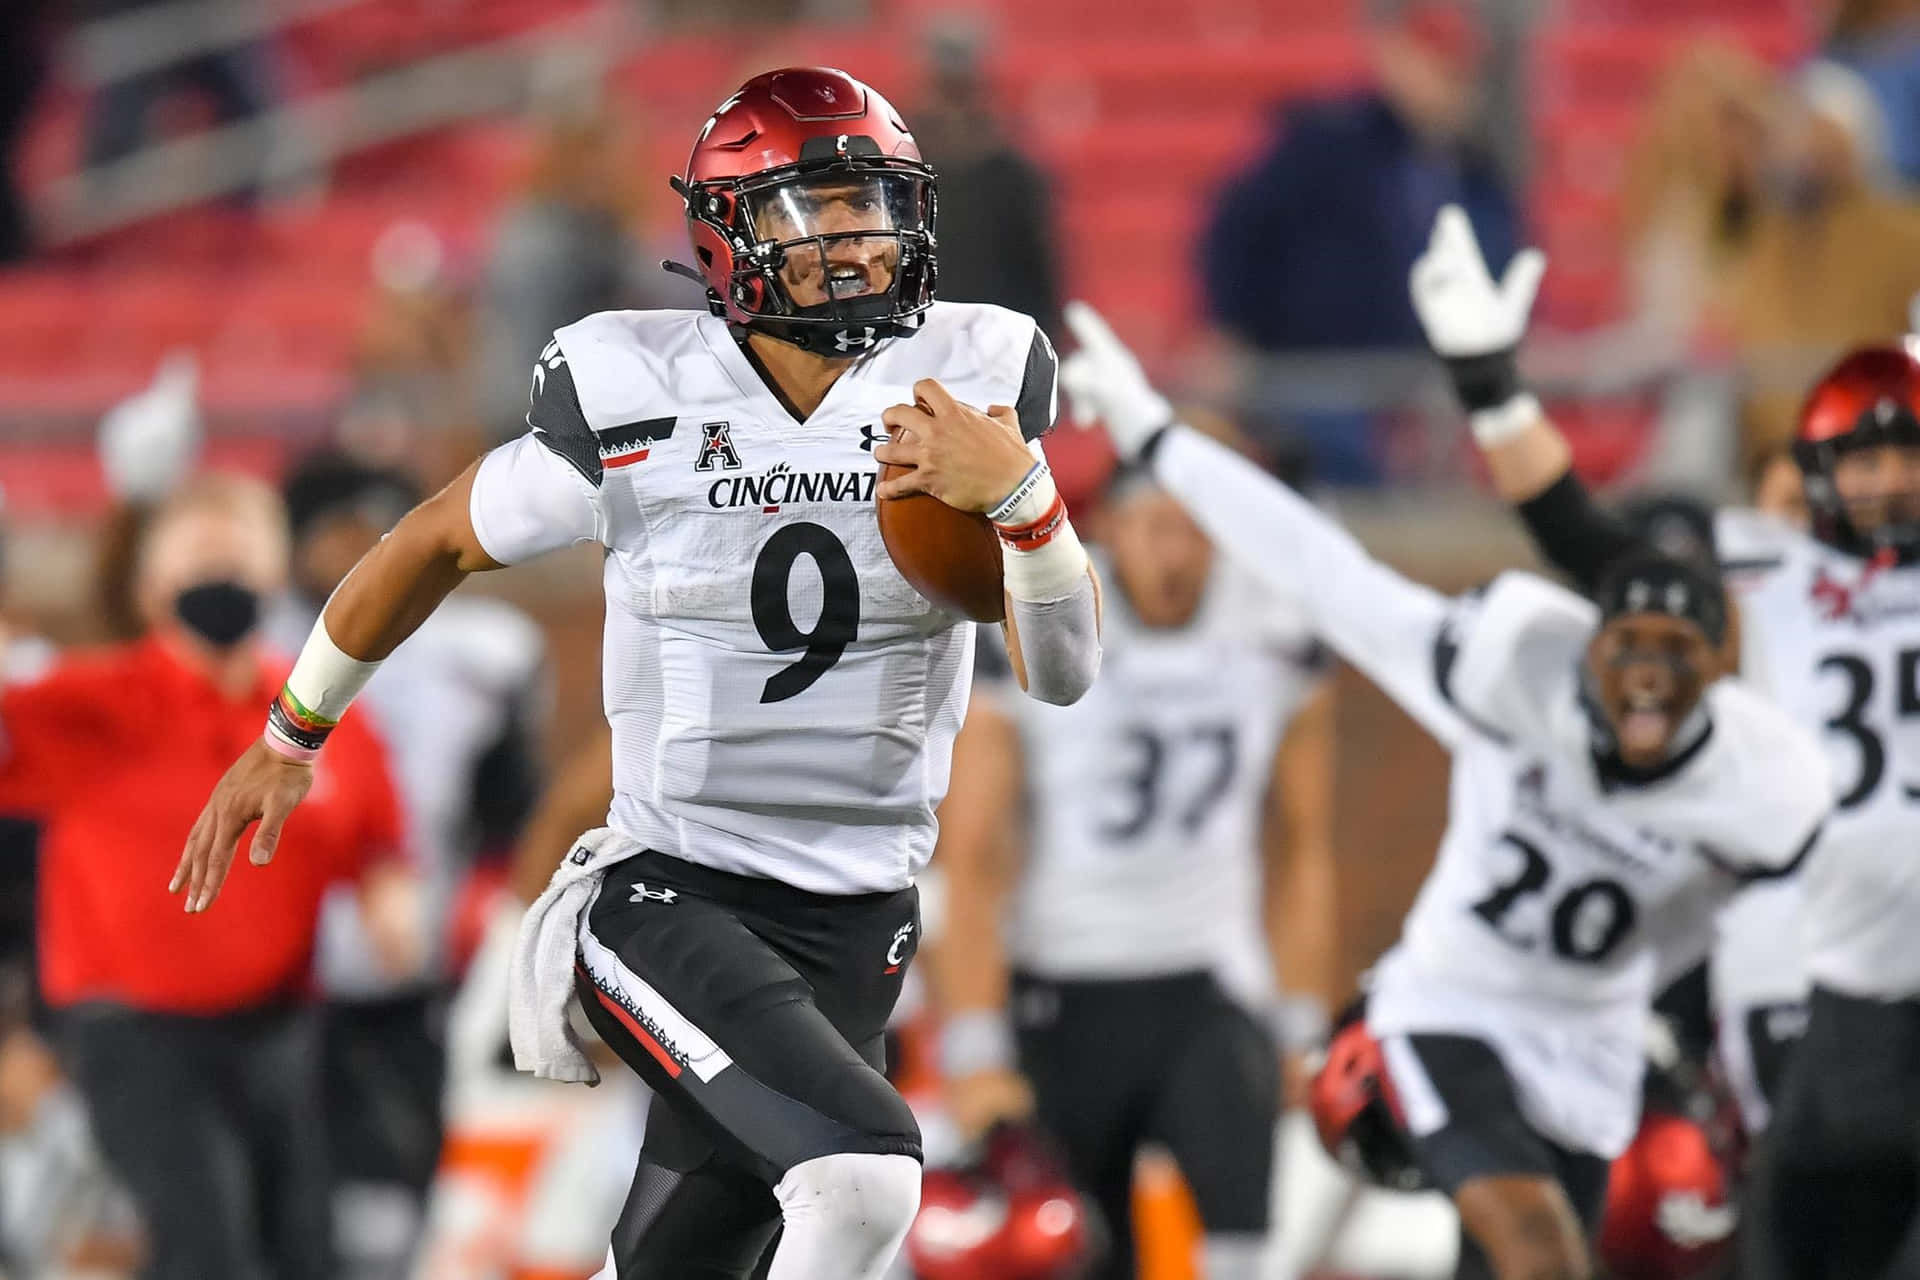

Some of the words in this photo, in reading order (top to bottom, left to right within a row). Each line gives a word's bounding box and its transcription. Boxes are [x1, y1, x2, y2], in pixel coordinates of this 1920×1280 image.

[695, 422, 742, 472] A
[708, 463, 878, 511] CINCINNAT
[750, 521, 860, 704] 9
[1098, 721, 1238, 843] 37
[1472, 829, 1636, 963] 20
